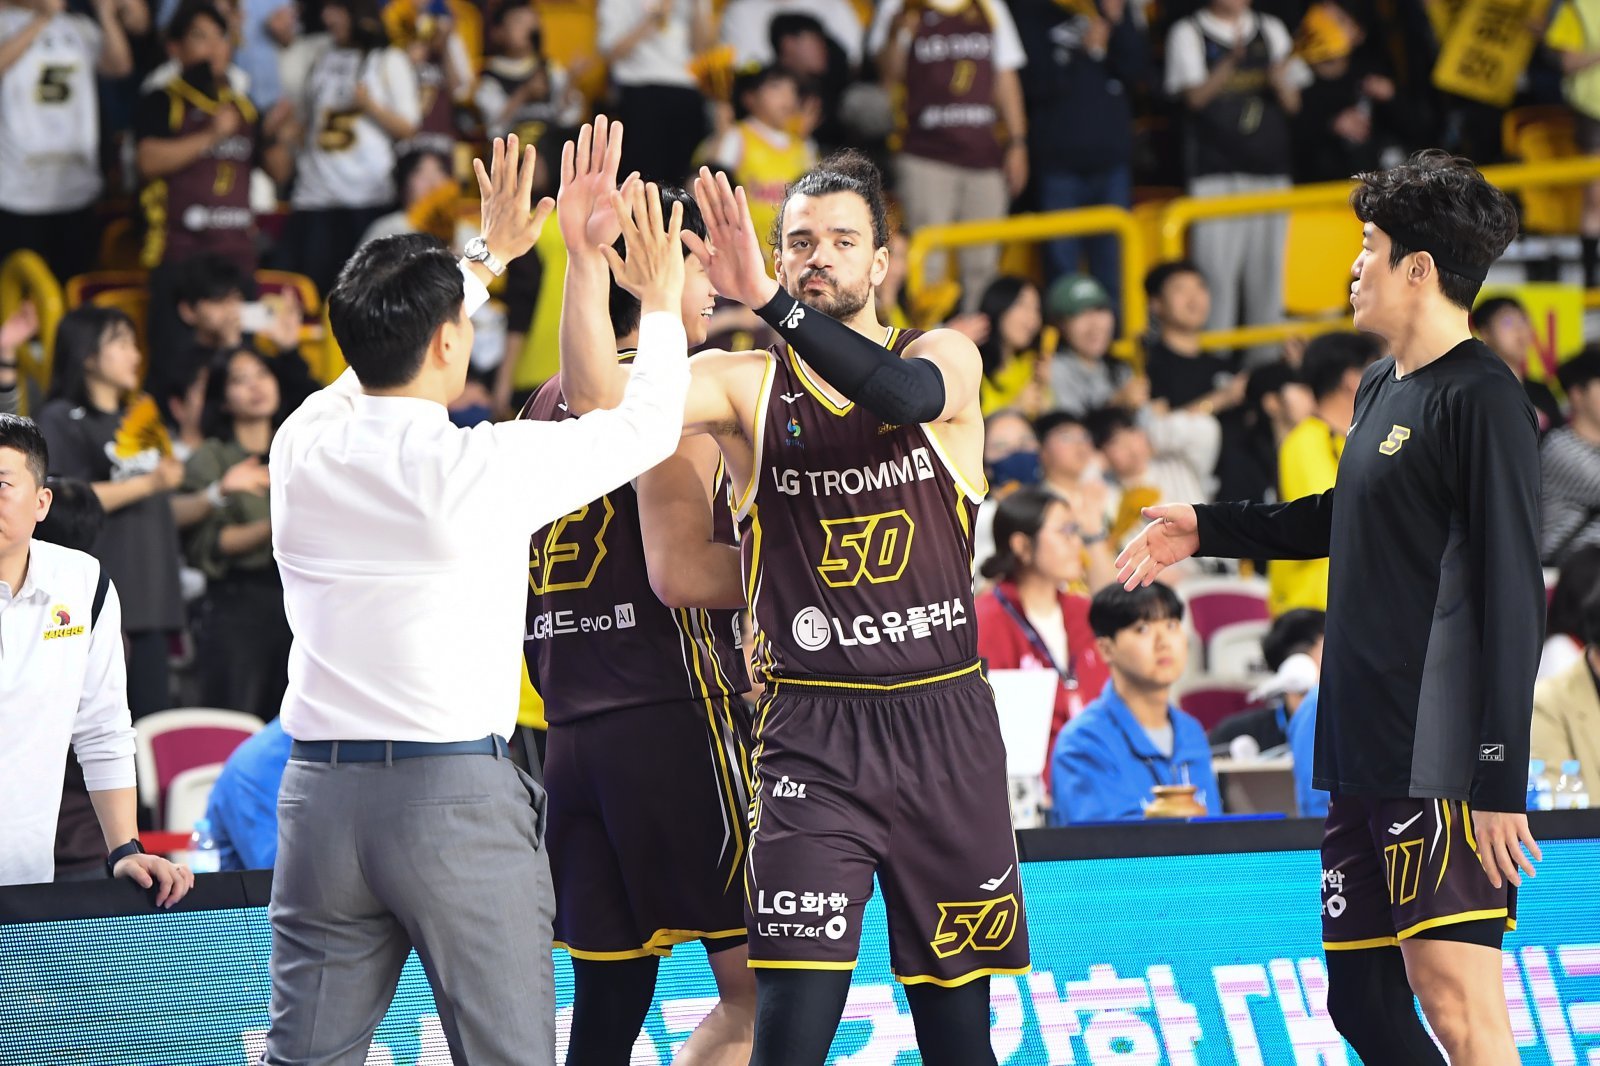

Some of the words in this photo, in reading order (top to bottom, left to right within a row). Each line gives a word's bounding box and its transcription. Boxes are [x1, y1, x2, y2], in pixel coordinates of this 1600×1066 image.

[771, 466, 801, 496] LG
[804, 455, 915, 497] TROMM
[816, 508, 915, 589] 50
[580, 614, 612, 633] evo
[757, 889, 849, 916] LG화학
[929, 892, 1019, 959] 50
